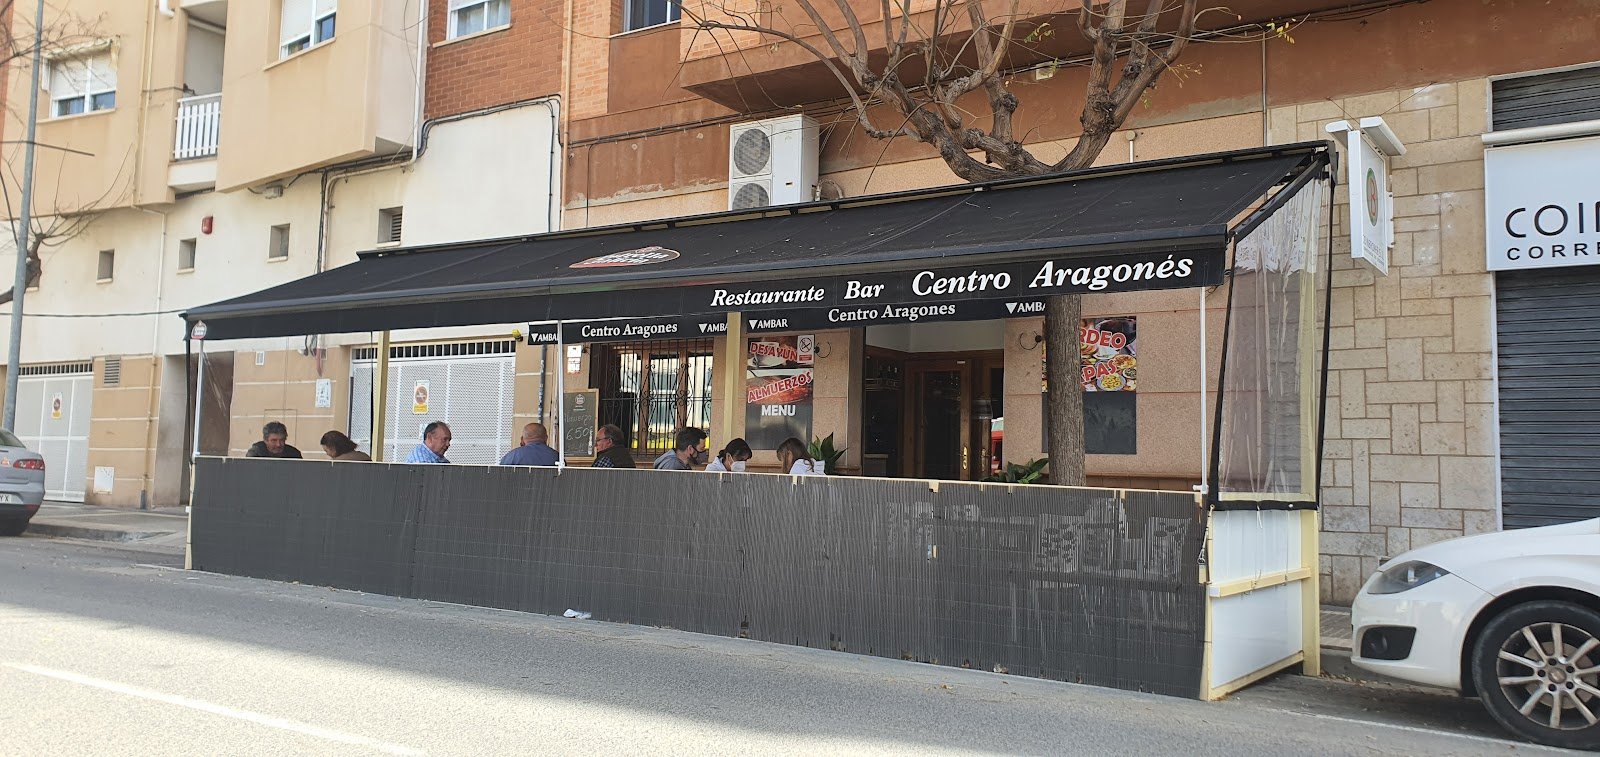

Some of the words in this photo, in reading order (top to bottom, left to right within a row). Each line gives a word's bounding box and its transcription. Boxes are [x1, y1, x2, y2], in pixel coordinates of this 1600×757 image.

[1505, 201, 1600, 238] COI
[711, 286, 825, 307] Restaurante
[844, 280, 885, 300] Bar
[912, 270, 1011, 296] Centro
[1028, 254, 1193, 290] Aragonés
[828, 307, 879, 323] Centro
[881, 303, 956, 323] Aragones
[581, 325, 621, 338] Centro
[622, 323, 678, 339] Aragones
[757, 318, 789, 330] AMBAR
[537, 332, 559, 342] AMBA
[1082, 359, 1118, 382] PAS
[748, 371, 812, 403] ALMUERZOS
[761, 404, 796, 417] MENU
